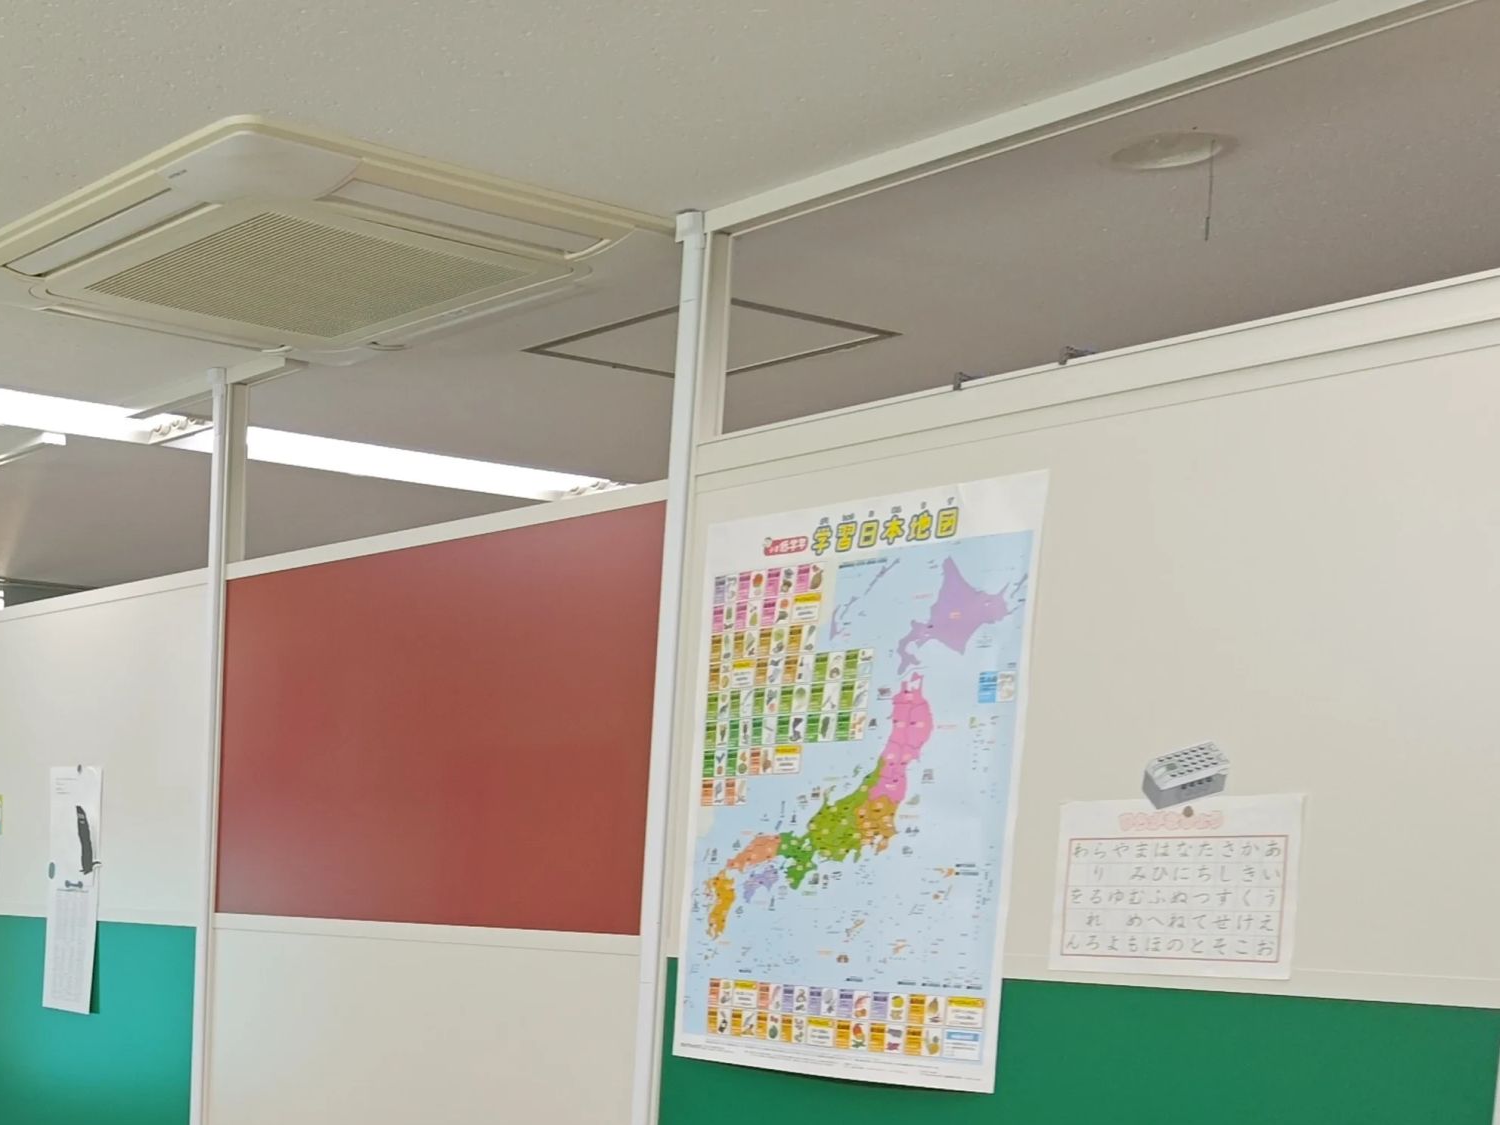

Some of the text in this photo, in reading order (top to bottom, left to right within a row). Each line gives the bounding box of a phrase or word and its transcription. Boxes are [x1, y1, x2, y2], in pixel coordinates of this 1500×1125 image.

[811, 506, 960, 556] 学習日本地図
